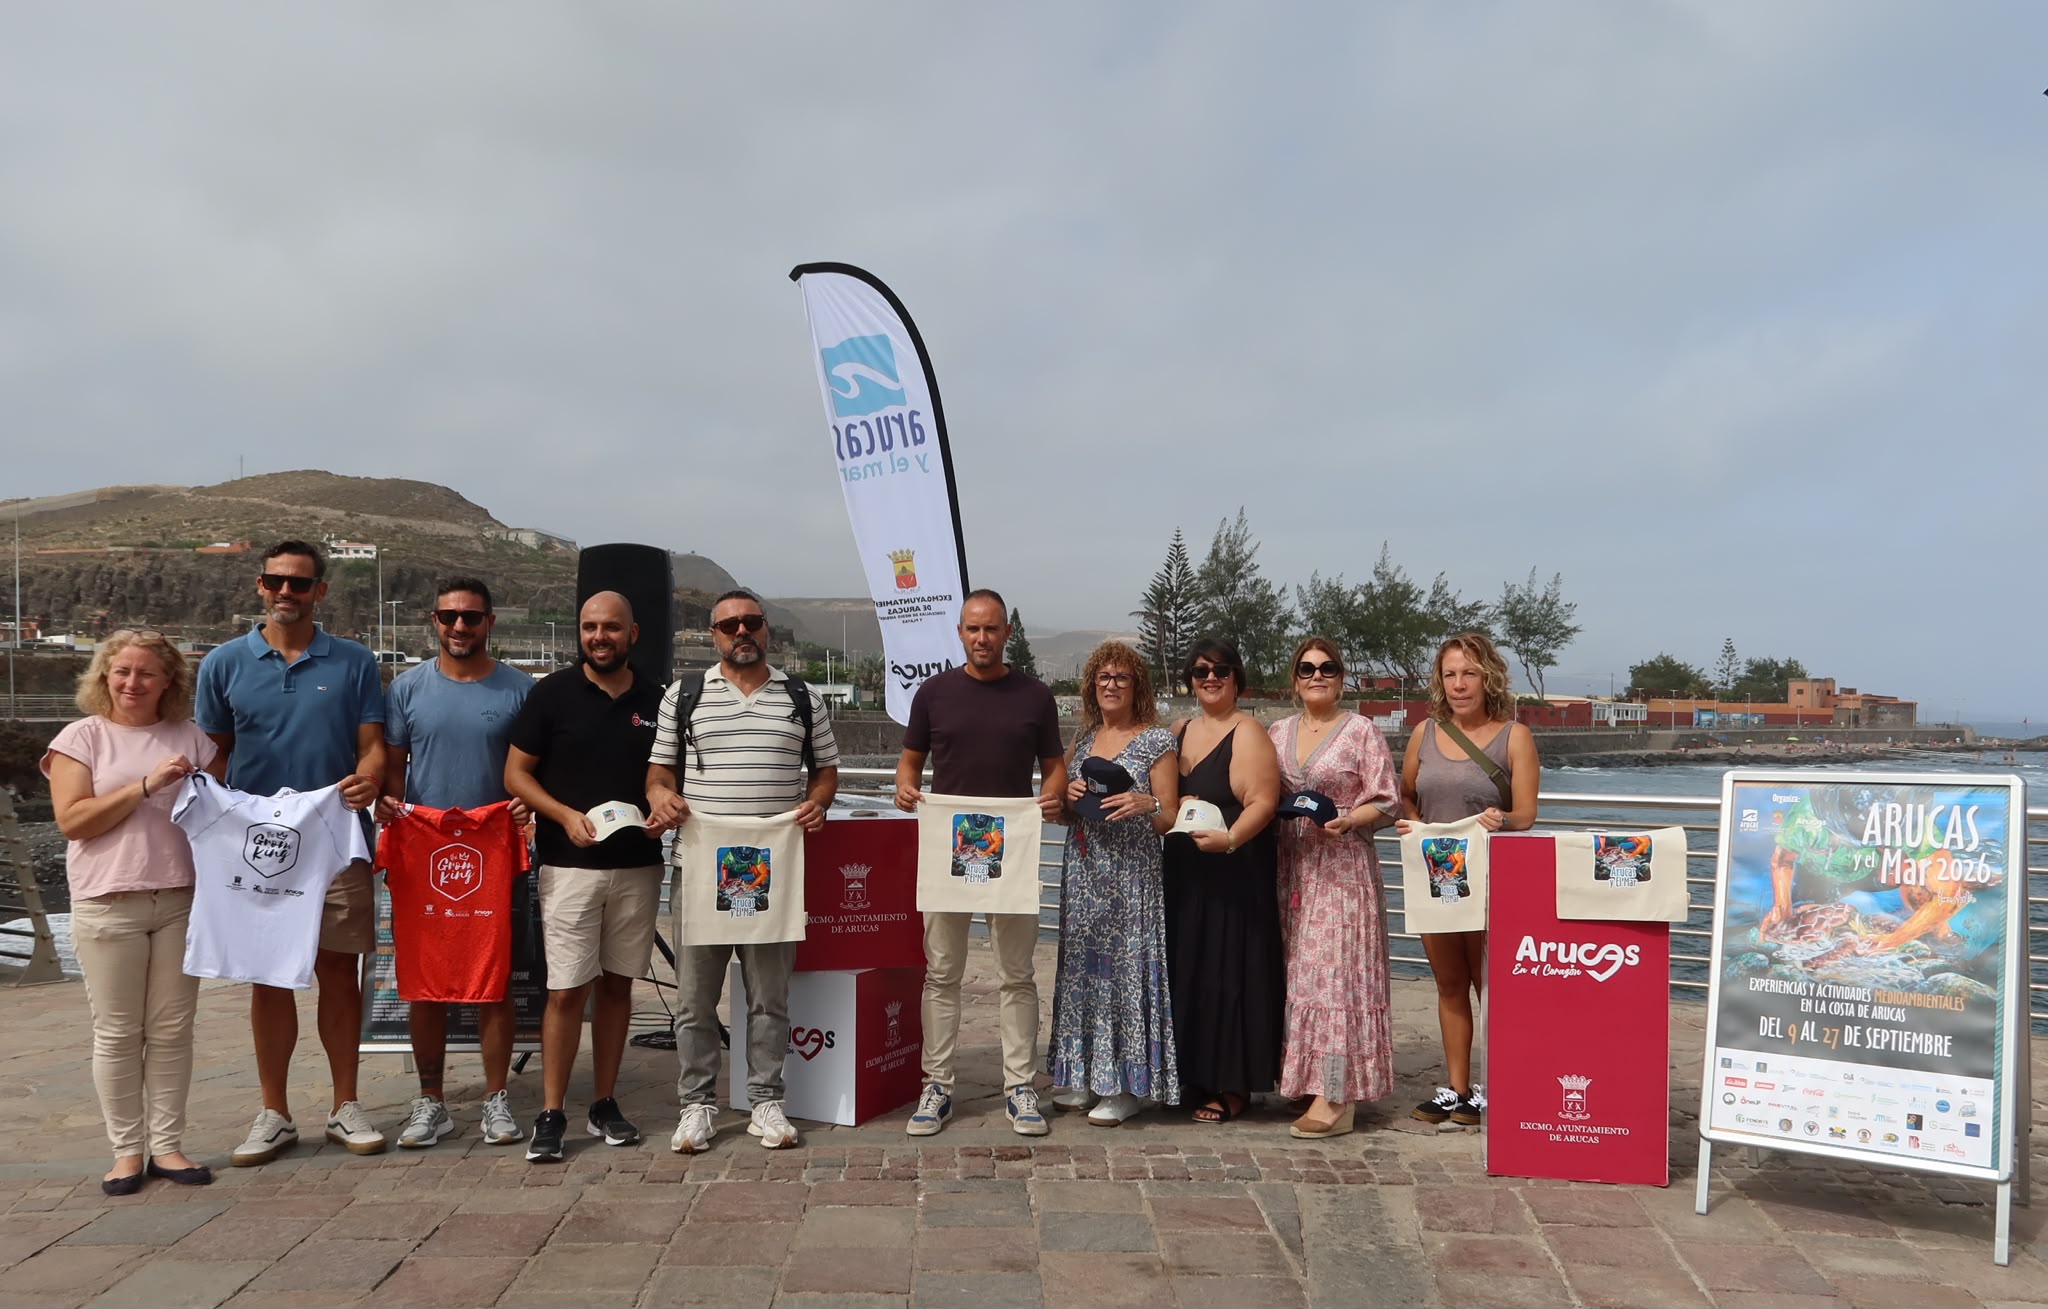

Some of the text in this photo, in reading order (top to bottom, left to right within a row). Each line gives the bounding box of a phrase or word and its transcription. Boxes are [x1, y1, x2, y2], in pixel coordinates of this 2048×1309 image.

[1861, 802, 1980, 853] ARUCAS
[252, 846, 291, 864] King
[1611, 866, 1637, 877] Arucas
[1853, 848, 1992, 887] y el Mar 2026
[439, 869, 476, 887] King
[732, 896, 756, 908] Arucas
[807, 912, 908, 924] XCMO. AYUNTAMIENTO
[831, 924, 880, 934] DE ARUCAS
[1515, 935, 1640, 982] Arucas
[1512, 962, 1582, 979] En el Corazón
[1749, 977, 1966, 1012] EXPERIENCIAS Y ACTIVIDADES MEDIOAMBIENTALES
[1800, 998, 1906, 1023] EN LA COSTA DE ARUCAS
[1759, 1015, 1953, 1058] DEL 9 AL 27 DE SEPTIEMBRE
[1519, 1121, 1630, 1136] EXCMO. AYUNTAMIENTO
[1549, 1133, 1600, 1144] DE ARUCAS
